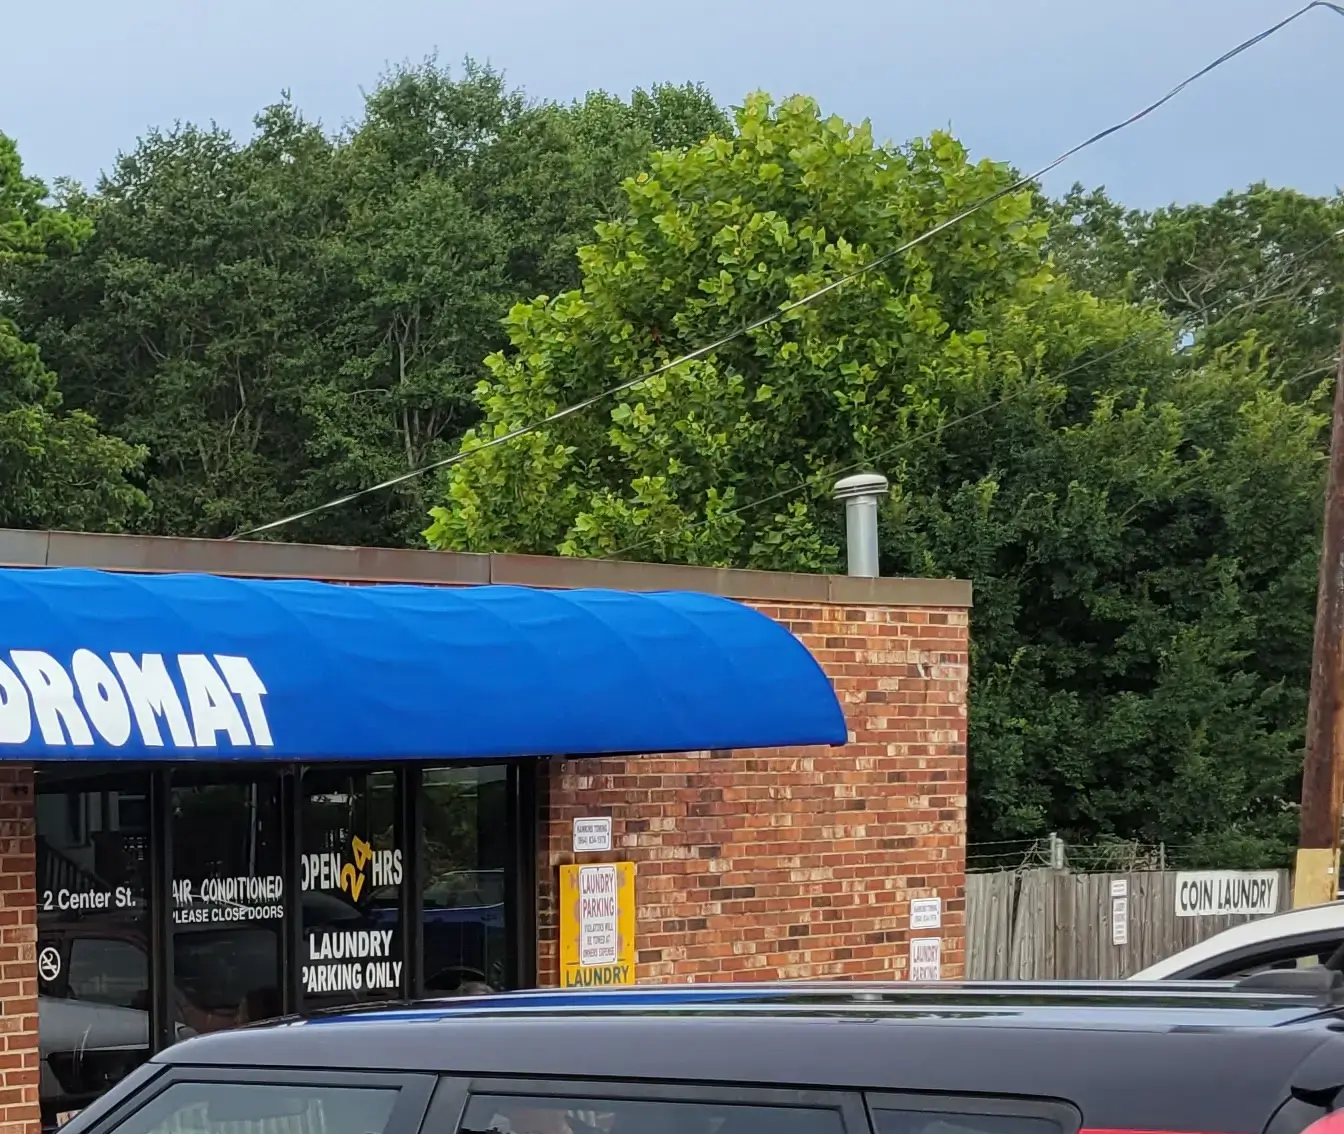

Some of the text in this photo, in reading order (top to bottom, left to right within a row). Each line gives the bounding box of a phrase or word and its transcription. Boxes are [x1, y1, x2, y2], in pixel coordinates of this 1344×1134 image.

[341, 835, 373, 902] 24
[372, 849, 403, 887] HRS
[173, 876, 283, 907] AIR CONDITIONED
[582, 874, 614, 894] LAUNDRY
[1181, 878, 1274, 911] COIN LAUNDRY
[43, 886, 136, 910] 2 Center St.
[583, 897, 614, 919] PARKING
[211, 907, 246, 922] CLOSE
[248, 905, 284, 919] DOORS
[310, 930, 393, 960] LAUNDRY
[366, 961, 402, 989] ONLY
[566, 965, 629, 988] LAUNDRY
